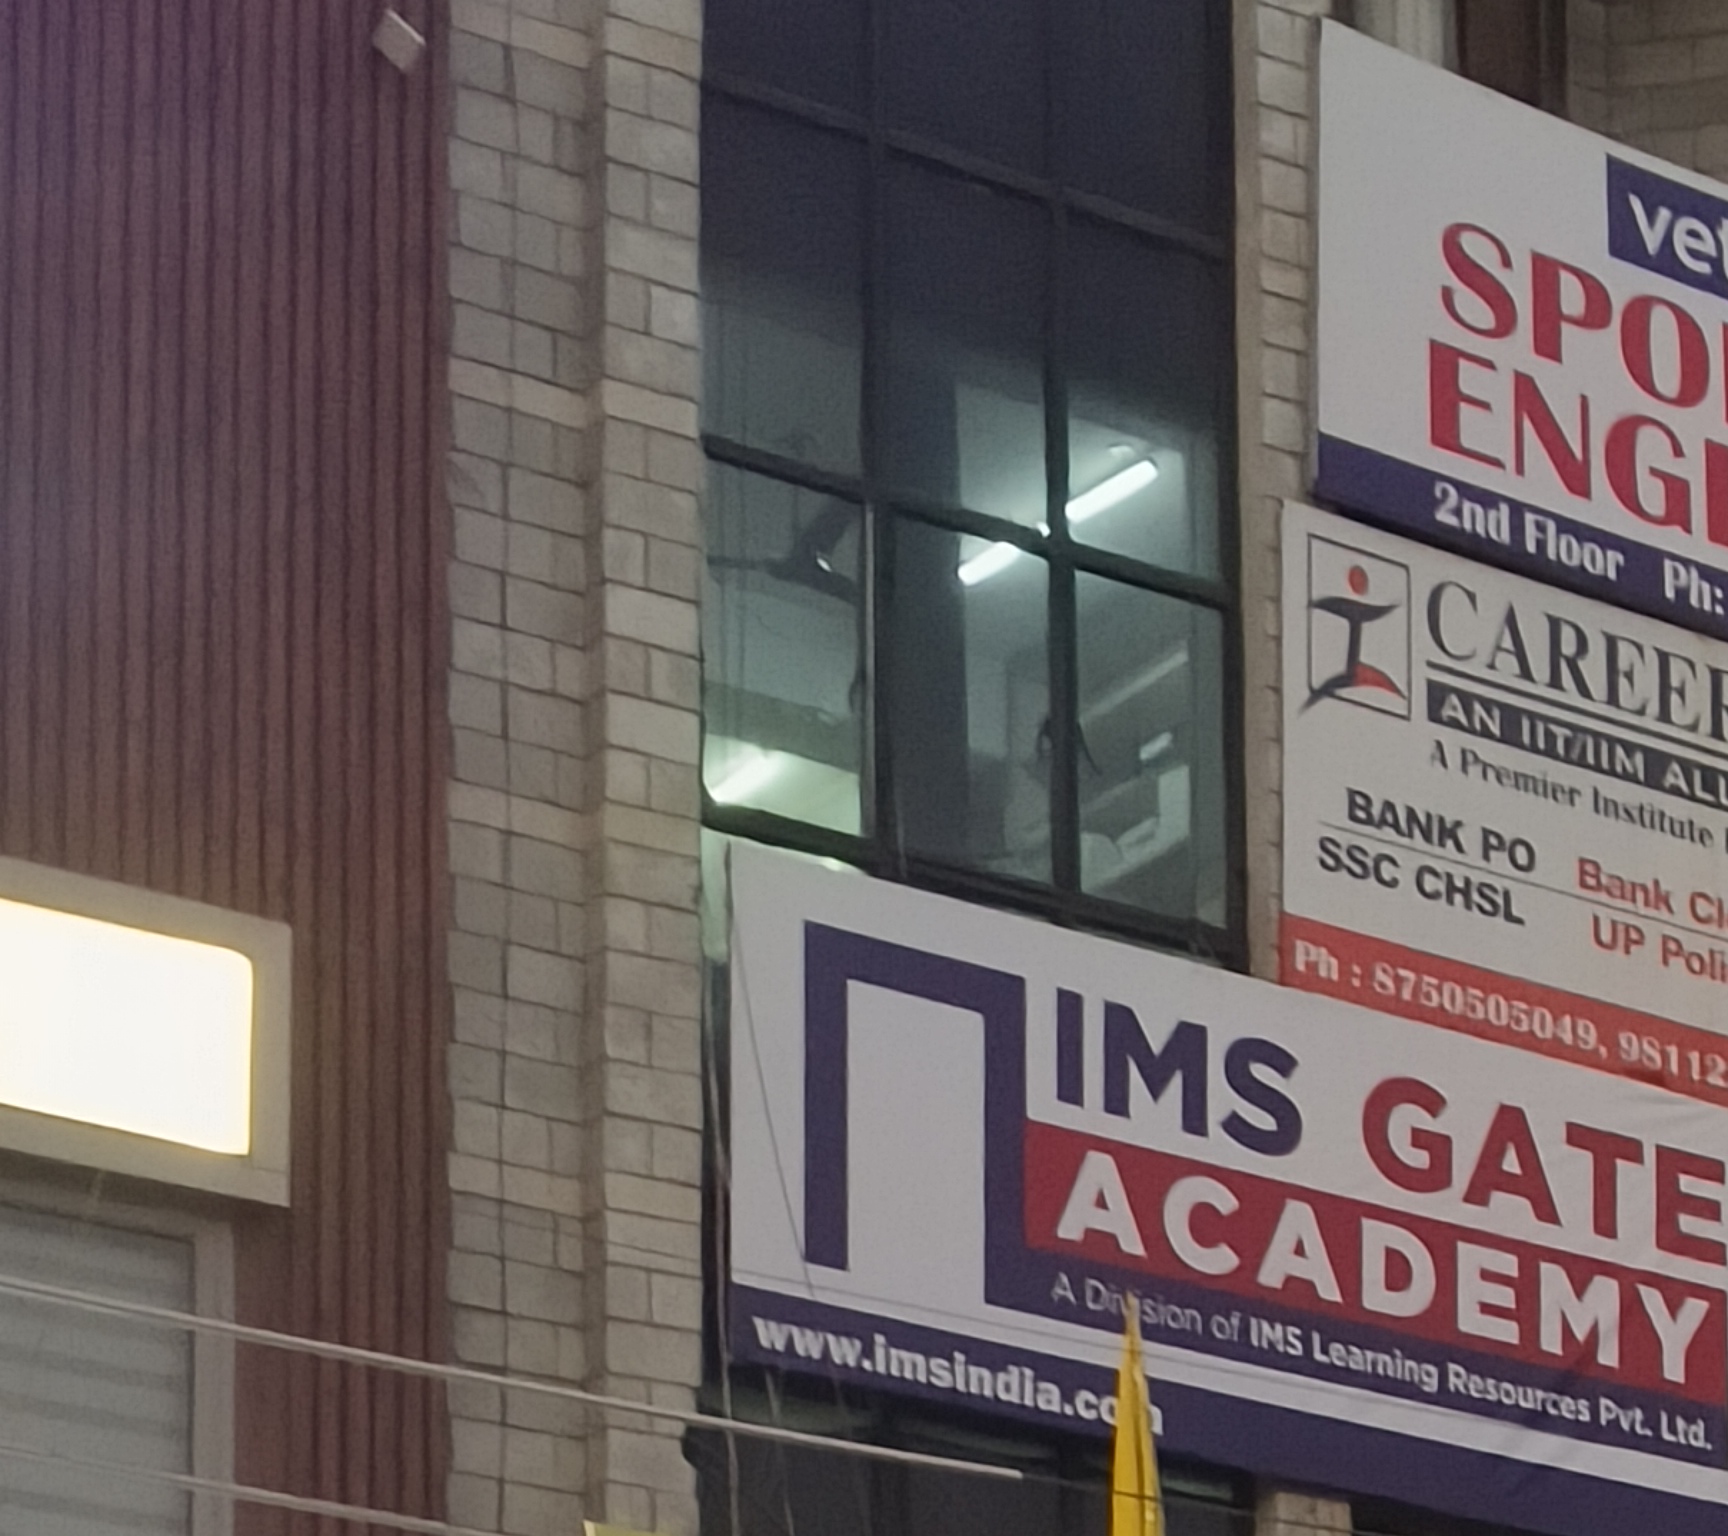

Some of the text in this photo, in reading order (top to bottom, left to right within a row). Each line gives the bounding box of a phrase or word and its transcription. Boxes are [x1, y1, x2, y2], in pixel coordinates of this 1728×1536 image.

[1434, 480, 1511, 547] 2nd
[1524, 508, 1624, 581] Floor
[1439, 695, 1503, 739] AN
[1521, 715, 1646, 779] IIT/IIM
[1345, 787, 1536, 875] BANK PO
[1431, 740, 1450, 772] A
[1459, 752, 1580, 810] Premier
[1591, 788, 1714, 850] Institute
[1317, 836, 1526, 926] SSC CHSL
[1577, 856, 1675, 917] Bank
[1590, 913, 1645, 957] UP
[1055, 987, 1303, 1158] IMS
[1056, 1149, 1710, 1386] ACADEMY
[1052, 1270, 1712, 1452] A Divsion of IMS Learning Resources Pvt. Ltd.
